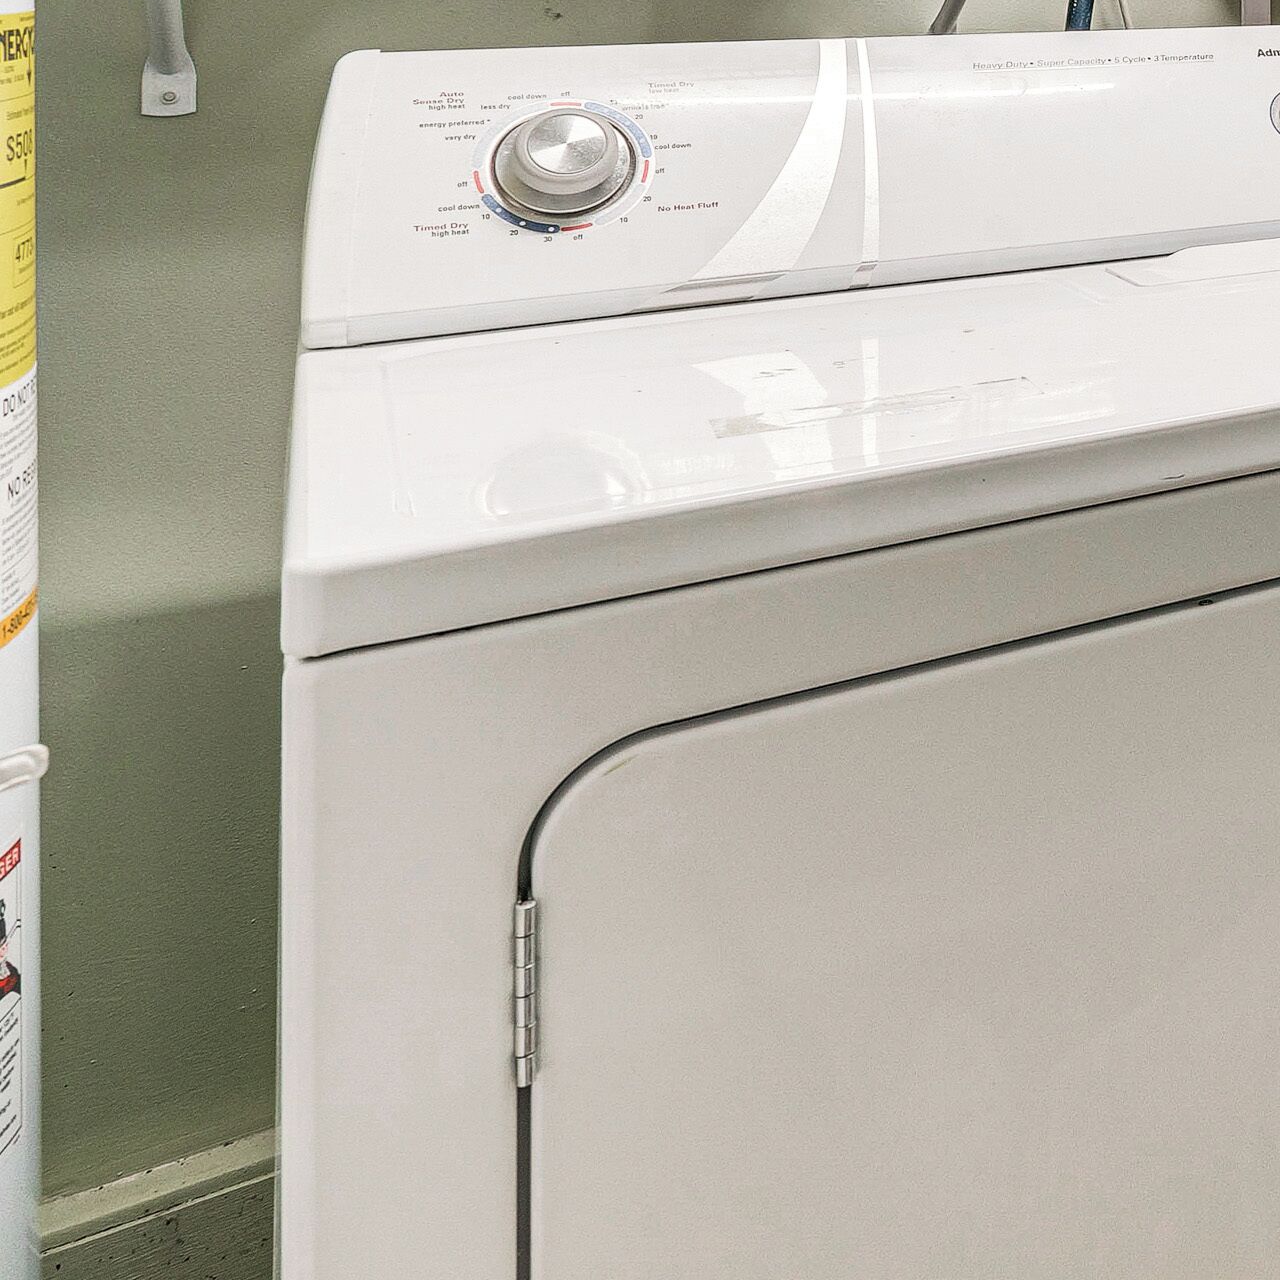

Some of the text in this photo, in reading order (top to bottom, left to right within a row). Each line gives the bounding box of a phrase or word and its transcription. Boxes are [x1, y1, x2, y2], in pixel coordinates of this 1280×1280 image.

[972, 62, 1002, 70] Heavy
[1037, 59, 1064, 68] Super
[1067, 58, 1106, 66] Capacity
[448, 119, 485, 127] preferred
[438, 203, 480, 212] cool down
[413, 222, 469, 232] Timed Dry
[431, 230, 449, 238] high
